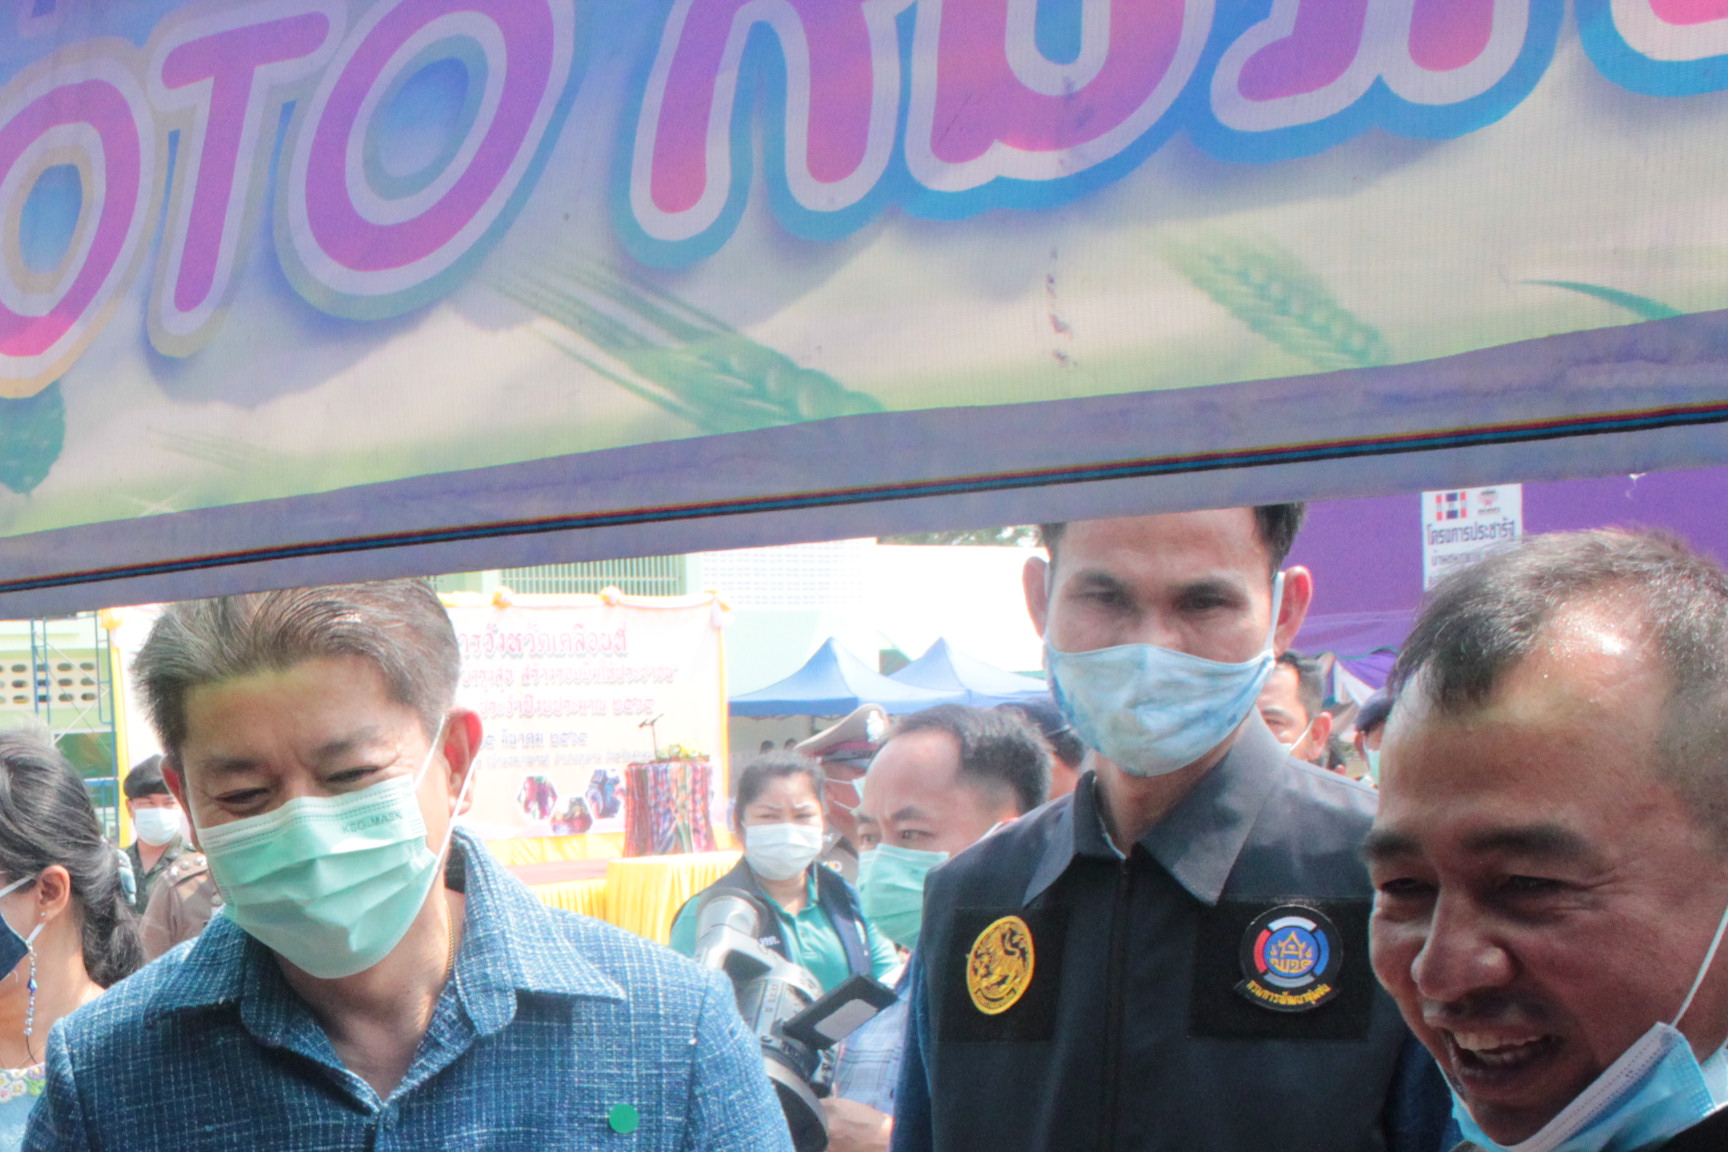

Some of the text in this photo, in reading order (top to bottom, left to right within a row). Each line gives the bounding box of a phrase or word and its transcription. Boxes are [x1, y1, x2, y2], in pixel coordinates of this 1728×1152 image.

[1427, 515, 1516, 546] โครงการประชารัฐ
